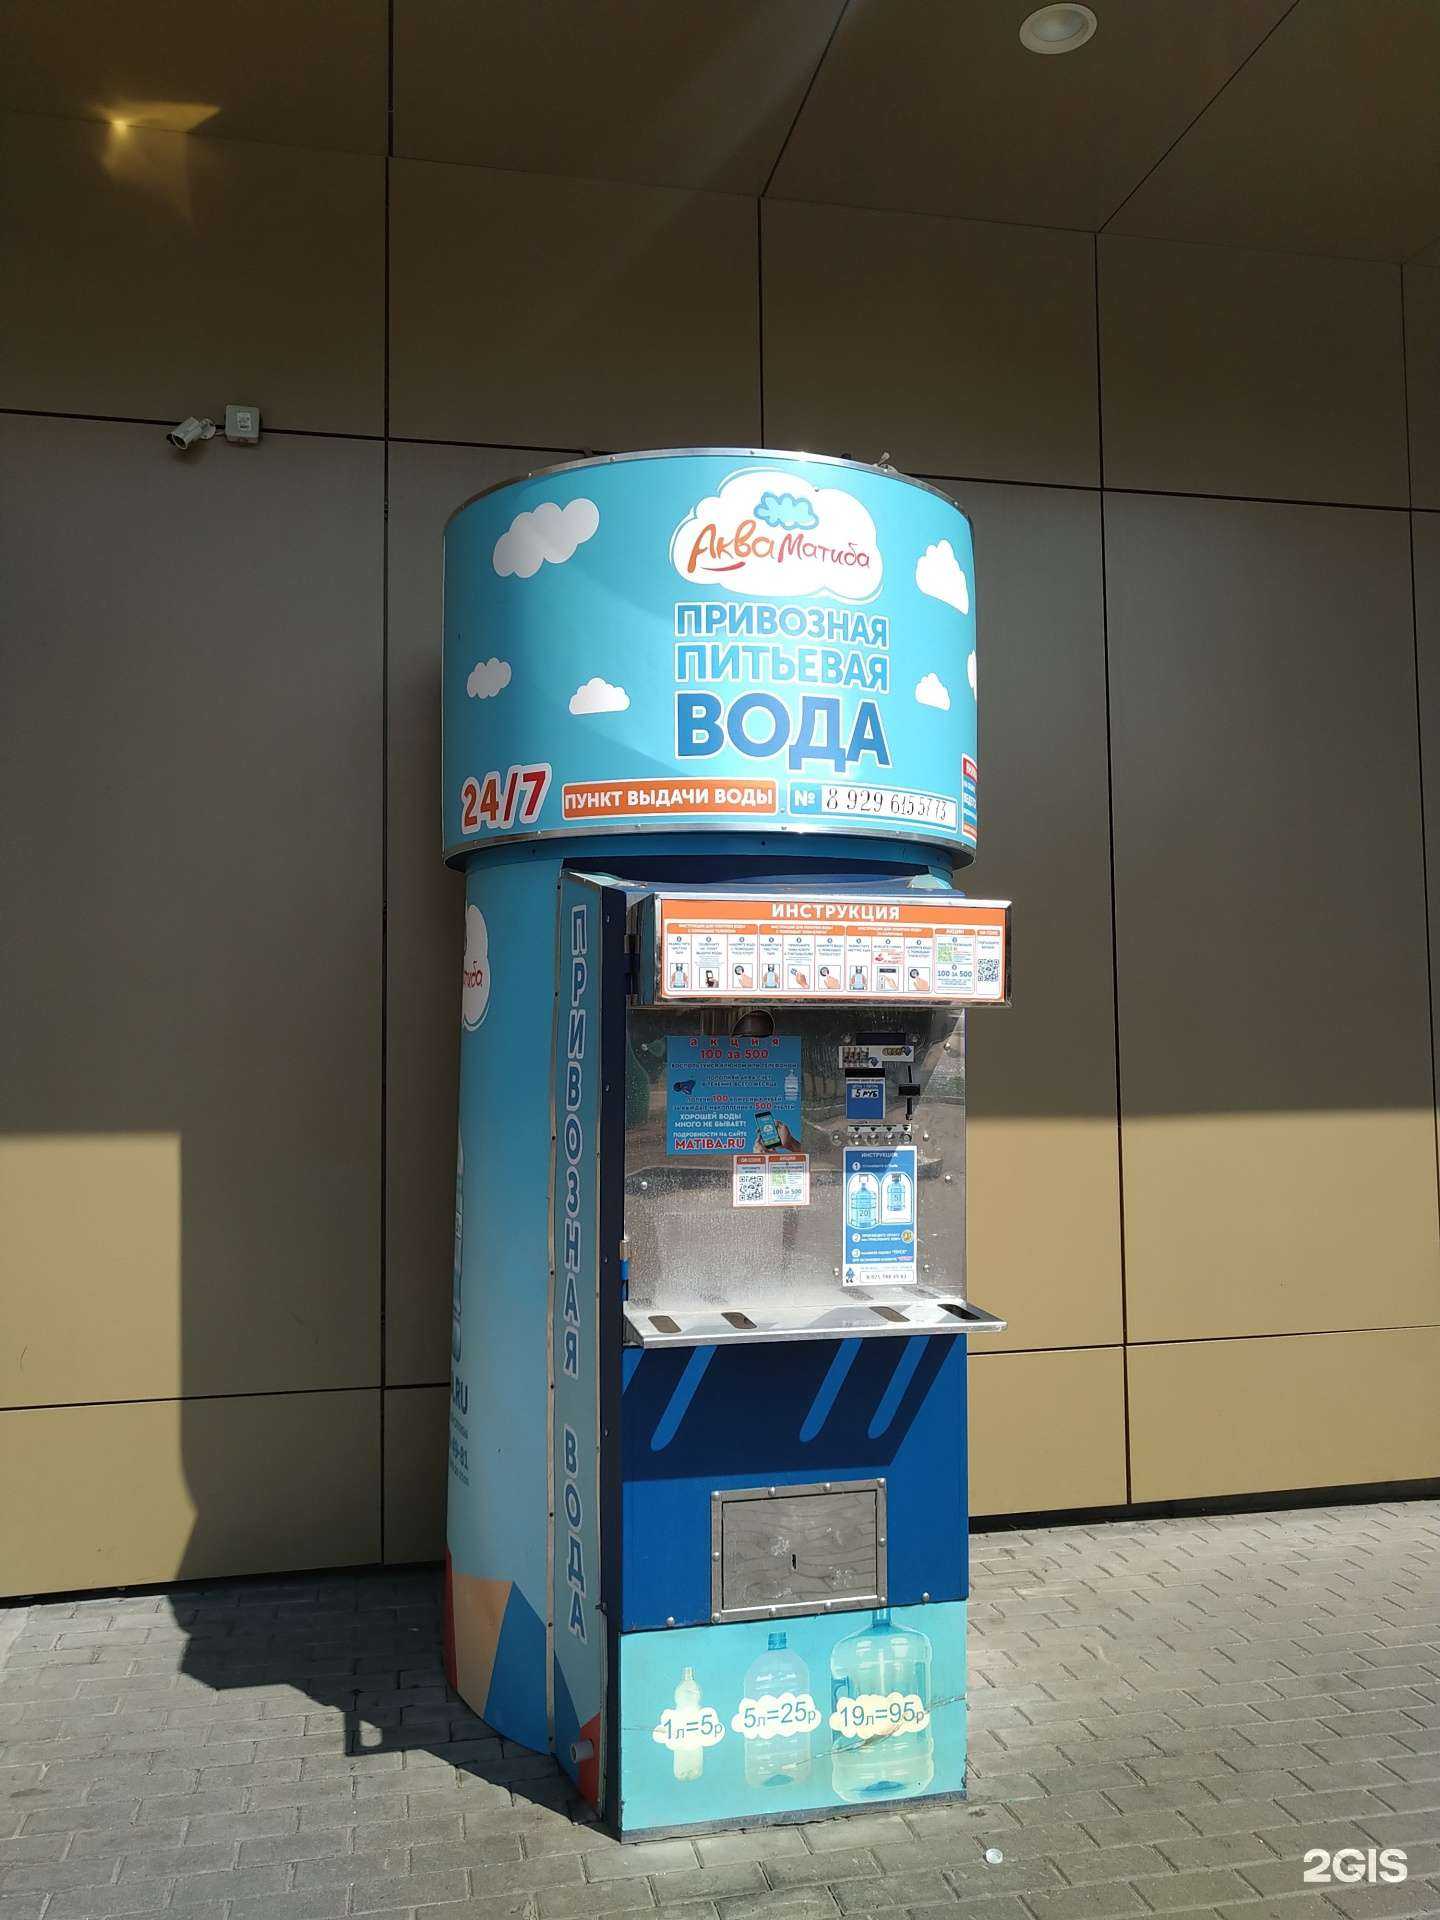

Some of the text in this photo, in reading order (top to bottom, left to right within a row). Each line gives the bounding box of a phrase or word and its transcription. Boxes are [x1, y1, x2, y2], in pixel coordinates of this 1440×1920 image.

[676, 604, 887, 648] ПРИВОЗНАЯ
[676, 644, 888, 691] ПИТЬЕВАЯ
[676, 692, 890, 772] ВОДА
[462, 768, 548, 829] 24/7
[565, 787, 772, 810] ПУНКТ ВЫДАЧИ ВОДЫ
[826, 788, 838, 810] 8
[846, 789, 884, 813] 929
[770, 904, 901, 921] ИНСТРУКЦИЯ
[959, 970, 973, 978] 500
[700, 1049, 723, 1060] 100
[744, 1049, 769, 1060] 500
[712, 1094, 729, 1102] 100
[855, 1089, 862, 1098] 5
[679, 1111, 717, 1120] ХОРОШЕЙ
[754, 1102, 772, 1111] 500
[563, 904, 588, 1380] ПРИВОЗНАЯ
[674, 1138, 746, 1151] MATIBA.RU
[563, 1423, 589, 1645] ВОДА
[743, 1701, 817, 1729] 5л=25р
[839, 1701, 924, 1727] 19л=95р
